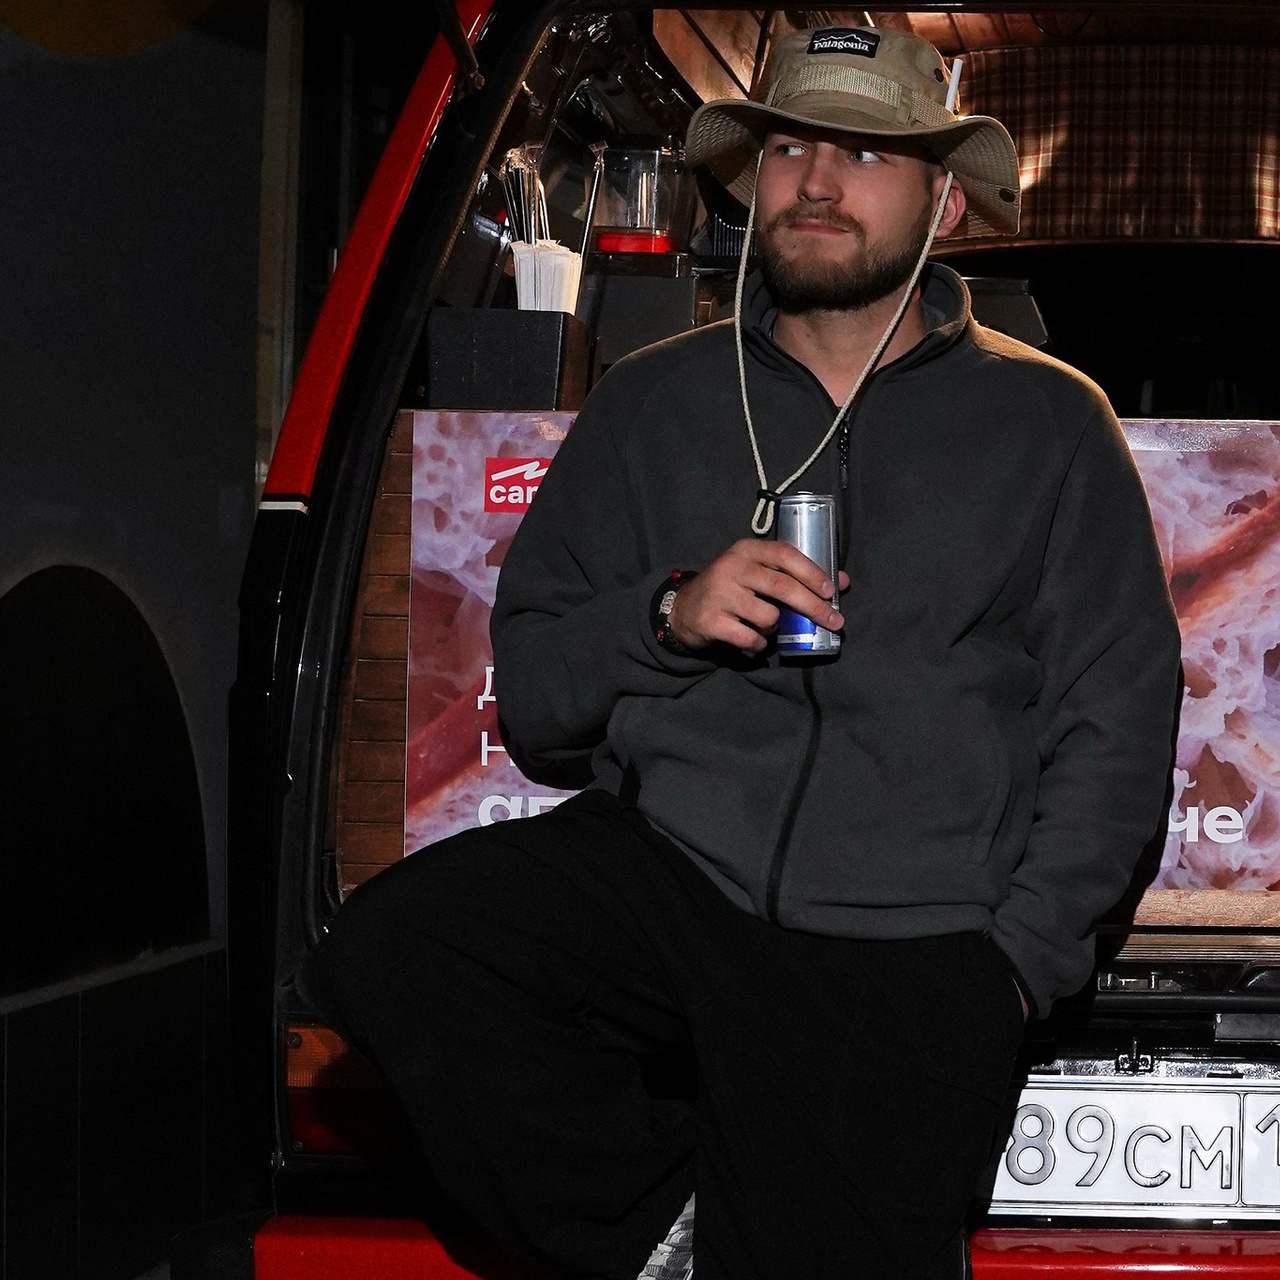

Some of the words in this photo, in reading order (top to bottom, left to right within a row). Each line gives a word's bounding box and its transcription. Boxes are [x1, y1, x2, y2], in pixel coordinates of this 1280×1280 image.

[813, 40, 869, 52] patagonia
[1168, 806, 1244, 844] че
[1005, 1104, 1233, 1189] 89CM
